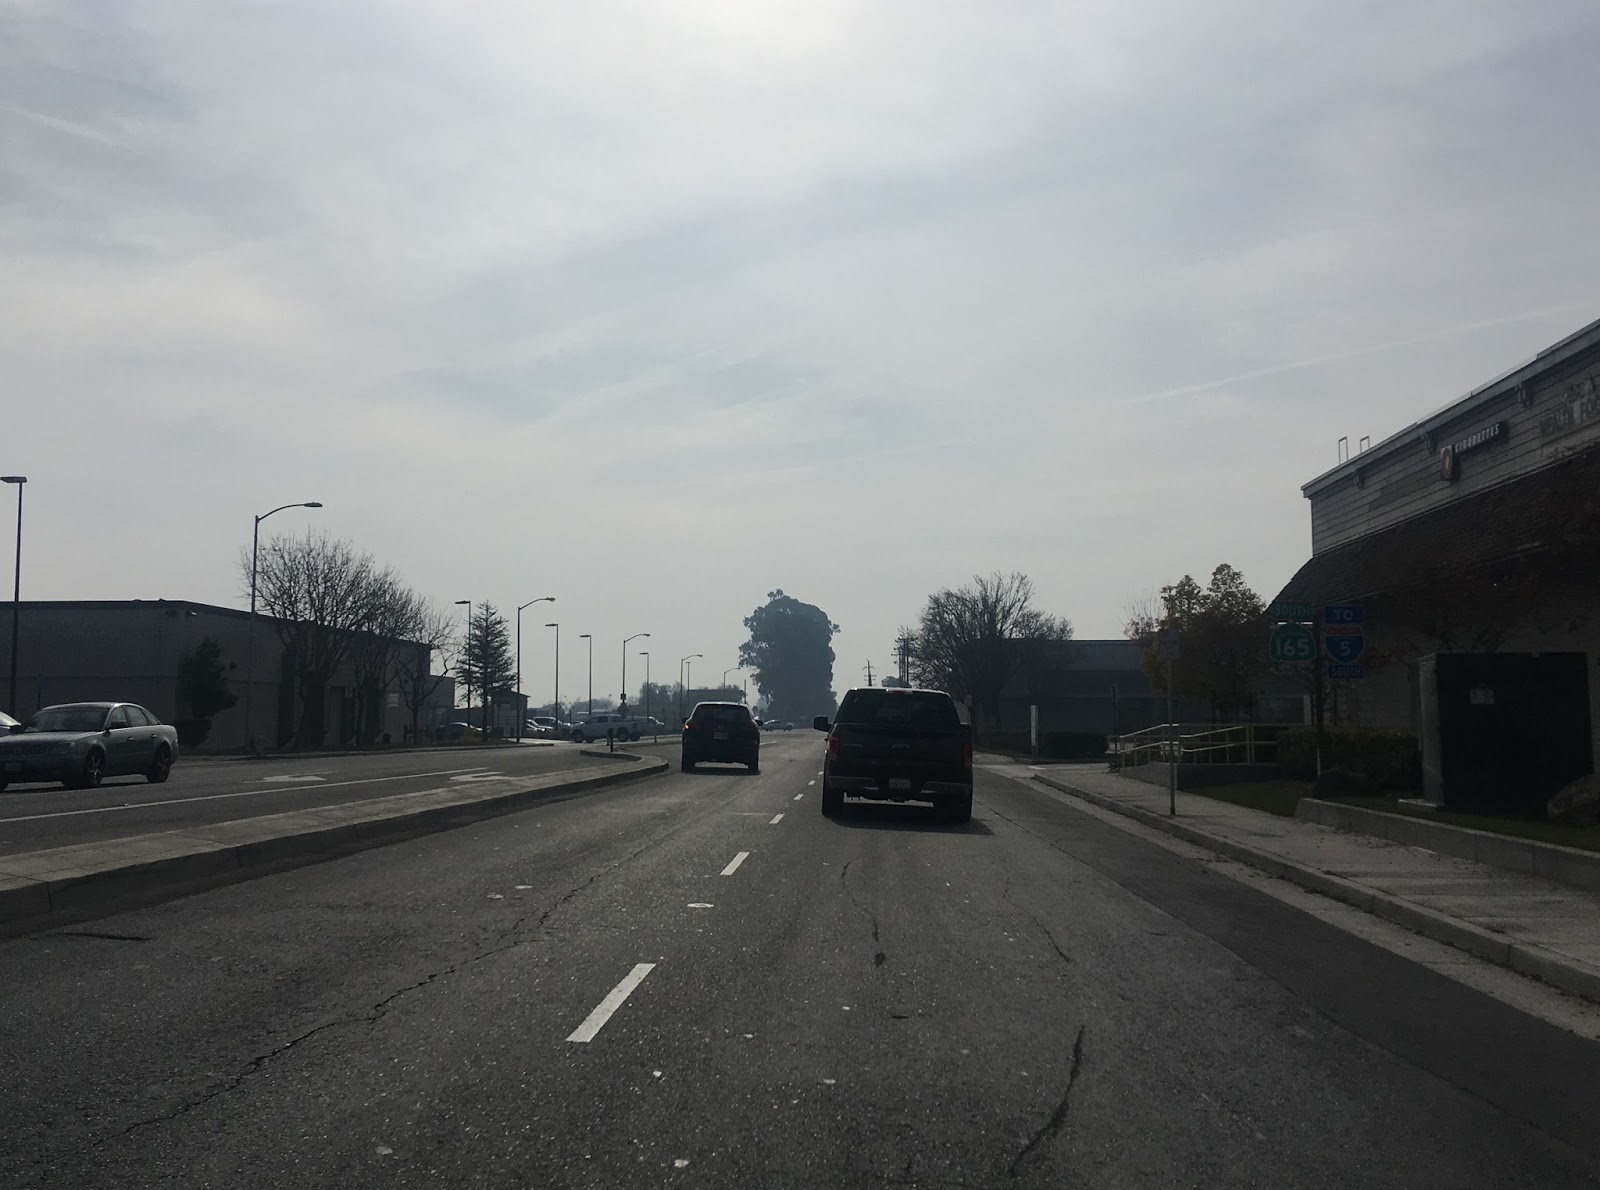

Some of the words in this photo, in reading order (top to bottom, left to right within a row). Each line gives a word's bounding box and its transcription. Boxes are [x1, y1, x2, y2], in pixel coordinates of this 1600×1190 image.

[1455, 424, 1500, 453] CIGARETTES
[1275, 603, 1312, 617] SOUTH
[1334, 609, 1354, 621] TO
[1275, 638, 1311, 657] 165
[1339, 640, 1351, 656] 5
[1330, 666, 1361, 677] SOUTH
